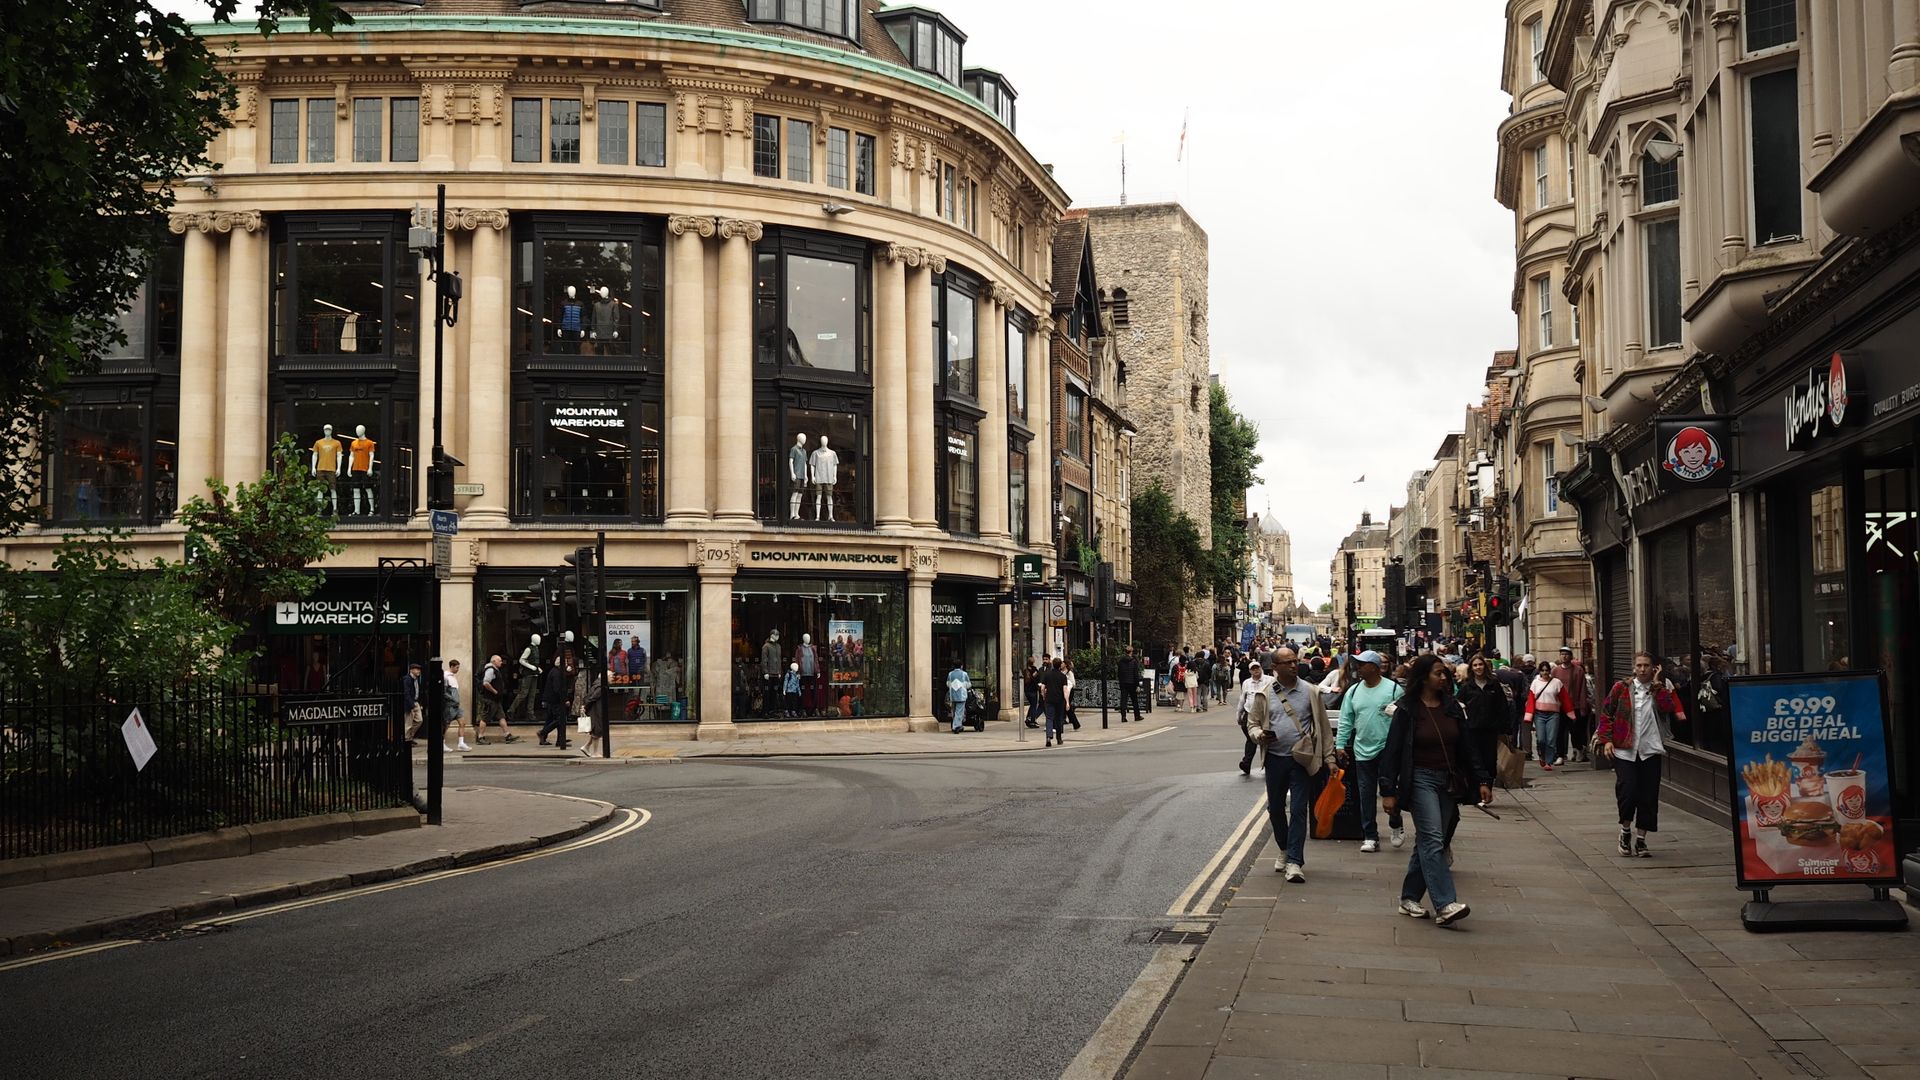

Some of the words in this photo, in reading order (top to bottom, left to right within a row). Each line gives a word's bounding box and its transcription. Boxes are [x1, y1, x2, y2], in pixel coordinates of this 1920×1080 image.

[556, 407, 618, 417] MOUNTAIN
[1785, 367, 1826, 451] Wendy's
[550, 418, 625, 428] WAREHOUSE
[947, 436, 966, 447] OUNTAIN
[707, 549, 730, 561] 1795
[761, 550, 828, 562] MOUNTAIN
[830, 553, 898, 565] WAREHOUSE
[919, 554, 932, 566] 1915
[301, 601, 390, 612] MOUNTAN
[931, 604, 957, 614] OUNTAIN
[931, 615, 963, 625] AREHOUSE
[1774, 695, 1836, 716] £9.99
[288, 705, 347, 721] MAGDALEN
[352, 703, 384, 717] STREET
[1766, 716, 1796, 730] BIG
[1799, 714, 1846, 729] DEAL
[1751, 729, 1809, 743] BIGGIE
[1812, 726, 1862, 741] MEAL
[1798, 858, 1840, 867] Summer
[1803, 866, 1835, 875] BIGGIE
